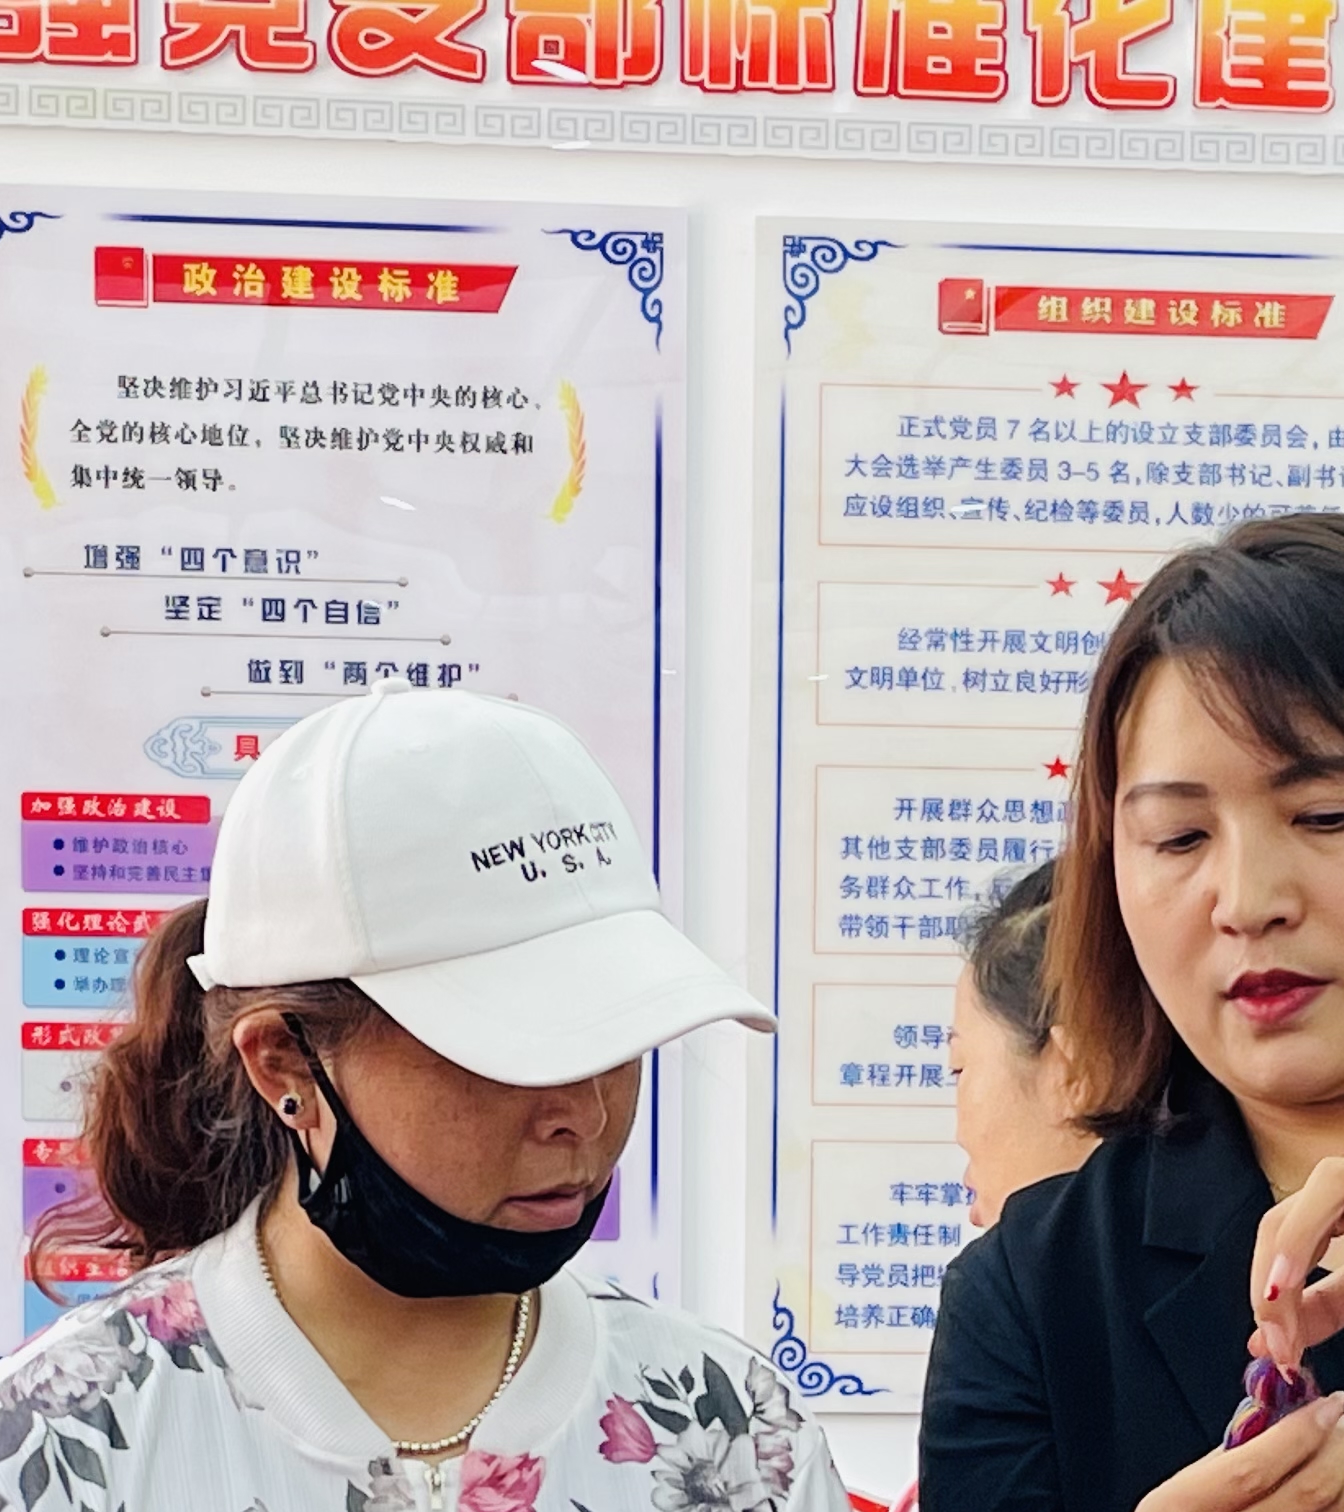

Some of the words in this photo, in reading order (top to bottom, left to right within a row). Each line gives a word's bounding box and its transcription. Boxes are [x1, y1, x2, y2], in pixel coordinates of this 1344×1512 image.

[183, 261, 461, 304] 政治建设标准
[1037, 295, 1287, 330] 组织建设标准
[70, 463, 237, 492] 集中统一领导。
[30, 796, 182, 820] 加强政治建设
[72, 836, 189, 856] 维护政治核心
[470, 836, 526, 872] NEW
[530, 823, 591, 854] YORK
[893, 1024, 956, 1050] 领导
[836, 1222, 962, 1248] 工作责任制
